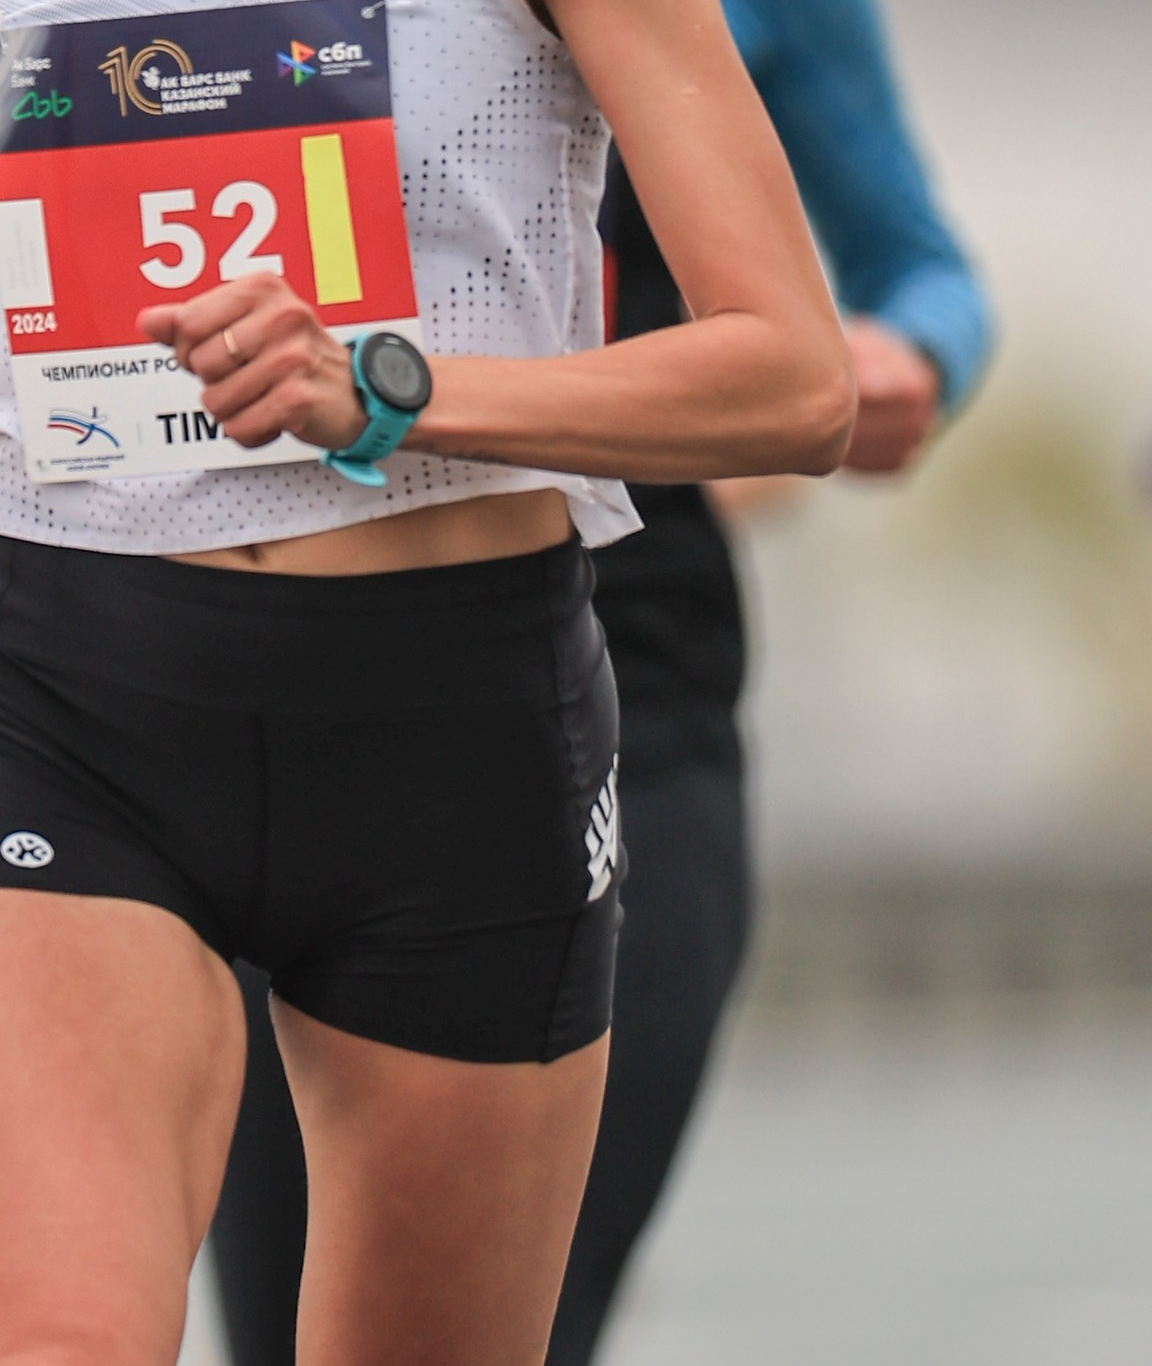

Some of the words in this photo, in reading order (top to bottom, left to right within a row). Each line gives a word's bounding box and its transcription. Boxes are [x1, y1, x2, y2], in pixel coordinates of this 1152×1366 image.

[317, 41, 363, 63] сбп
[160, 76, 179, 90] АК
[179, 73, 214, 88] БАРС
[215, 68, 253, 84] БАНК
[160, 81, 243, 102] КАЗАНСКИЙ
[160, 97, 228, 115] МАРАФОН
[139, 179, 285, 289] 52
[11, 310, 57, 335] 2024
[41, 359, 149, 383] ЧЕМПИОНАТ
